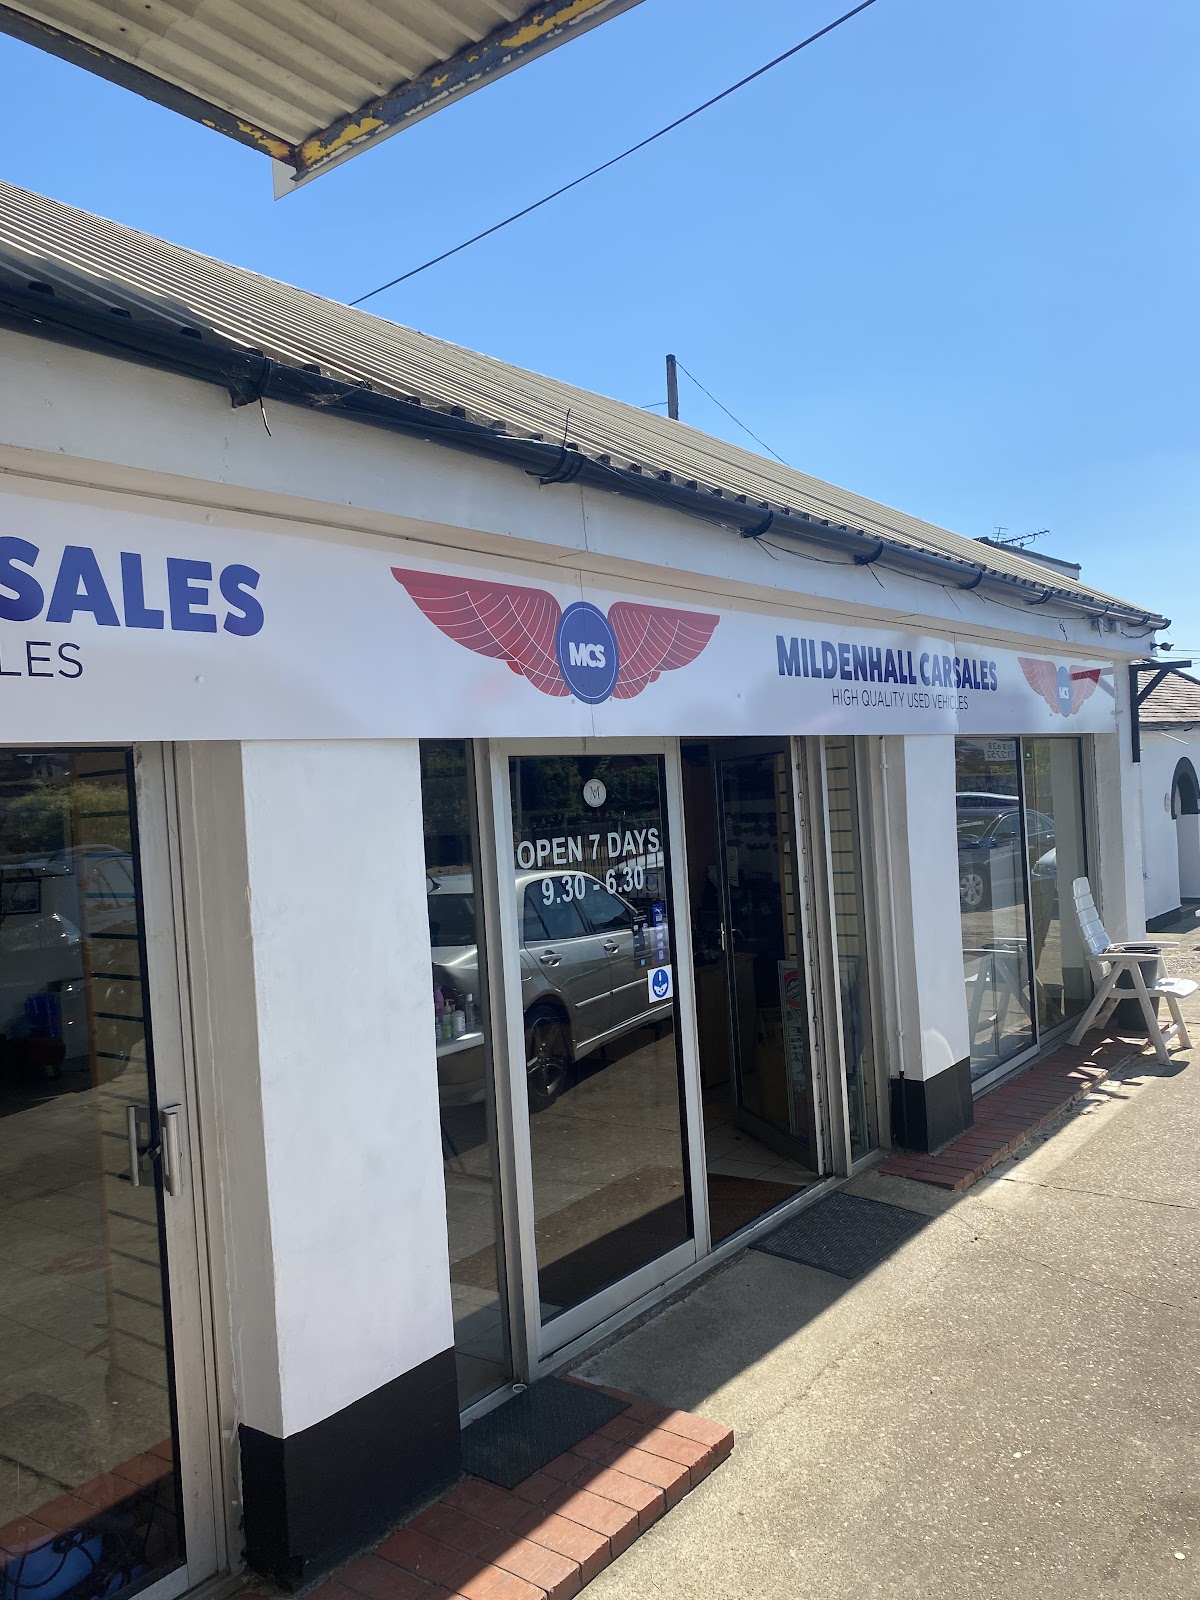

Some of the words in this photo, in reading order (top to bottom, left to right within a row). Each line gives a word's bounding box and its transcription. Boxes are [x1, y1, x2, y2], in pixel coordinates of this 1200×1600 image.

[568, 641, 606, 668] MCS
[775, 634, 918, 685] MILDENHALL
[831, 687, 859, 706] HIGH
[861, 689, 905, 707] QUALITY
[907, 691, 931, 709] USED
[931, 693, 969, 710] VEHICLES
[1058, 686, 1070, 699] MCS
[516, 835, 583, 869] OPEN
[588, 833, 601, 860] 7
[606, 827, 660, 858] DAYS
[541, 873, 586, 906] 9.30
[605, 865, 644, 895] 6.30
